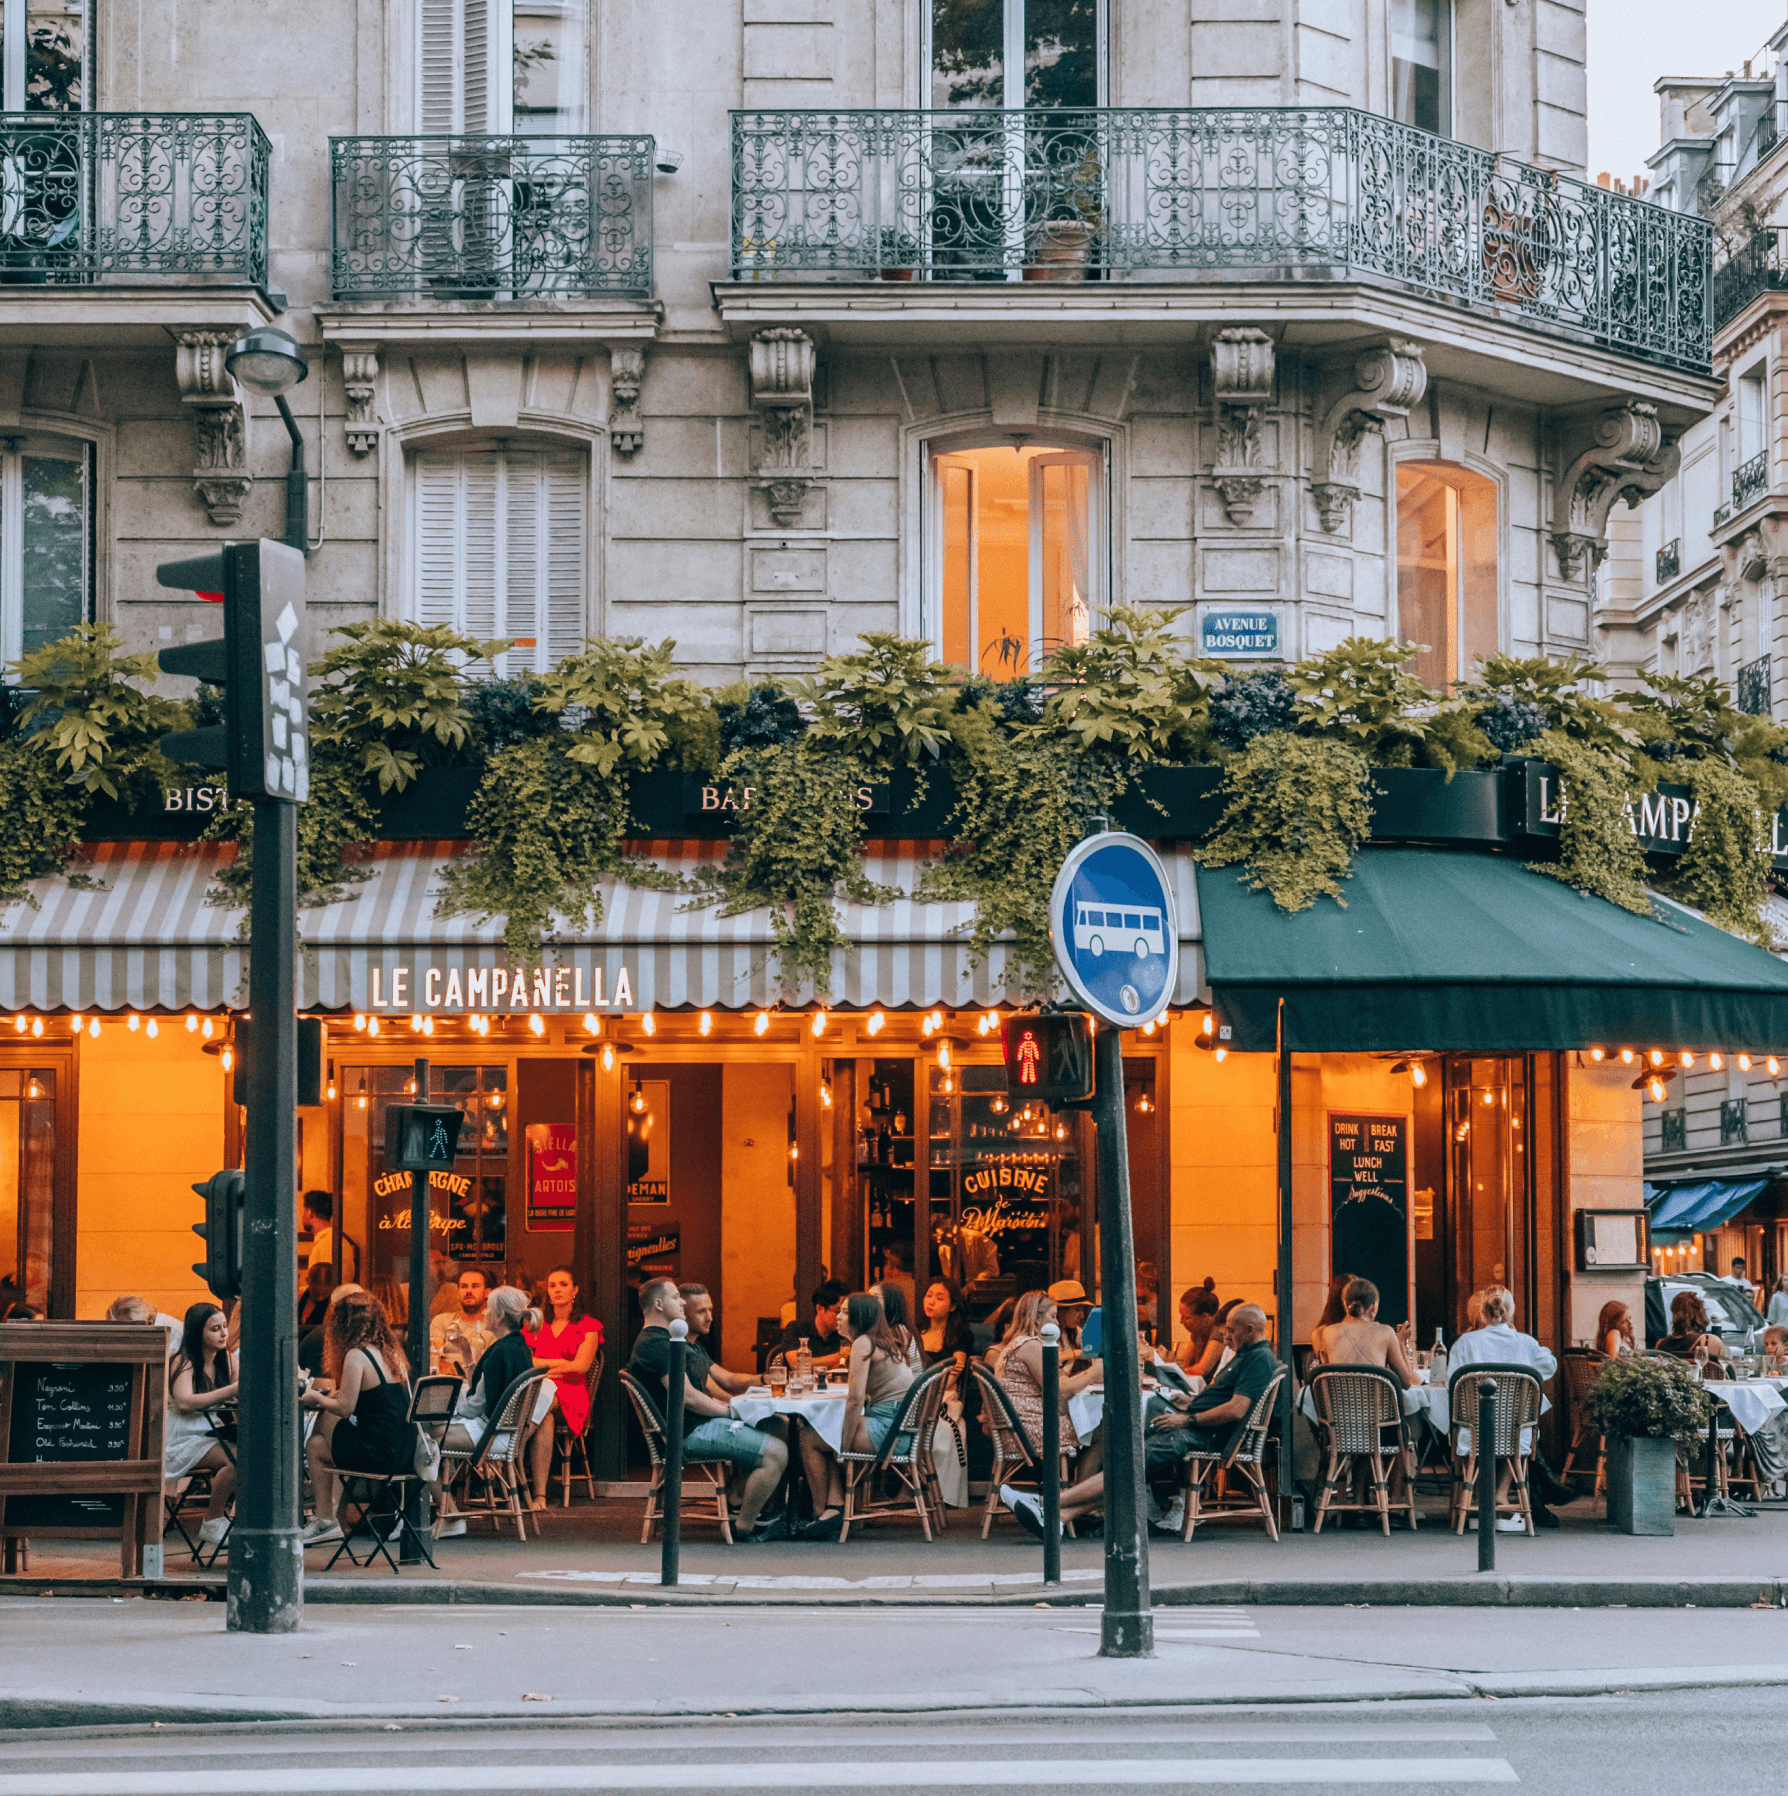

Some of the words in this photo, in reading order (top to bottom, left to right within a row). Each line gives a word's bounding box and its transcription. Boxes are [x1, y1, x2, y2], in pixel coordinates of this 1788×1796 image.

[1215, 617, 1268, 630] AVENUE
[1205, 634, 1275, 650] BOSQUET
[372, 967, 409, 1007] LE
[424, 966, 633, 1008] CAMPANELLA
[1334, 1122, 1360, 1135] DRINK
[1370, 1124, 1398, 1137] BREAK
[1339, 1138, 1356, 1150] HOT
[1374, 1140, 1395, 1152] FAST
[1353, 1156, 1382, 1168] LUNCH
[964, 1167, 1049, 1194] CUISINE
[1353, 1170, 1379, 1182] WELL
[374, 1170, 472, 1197] CHAMAGNE
[534, 1179, 576, 1193] ARTOIS
[1344, 1183, 1393, 1204] Suggestions
[450, 1243, 504, 1251] SPA-MOOPOLE
[37, 1377, 75, 1398] Negroni
[35, 1398, 57, 1411] Tom
[59, 1398, 91, 1413] Collins
[73, 1418, 102, 1430] Martini
